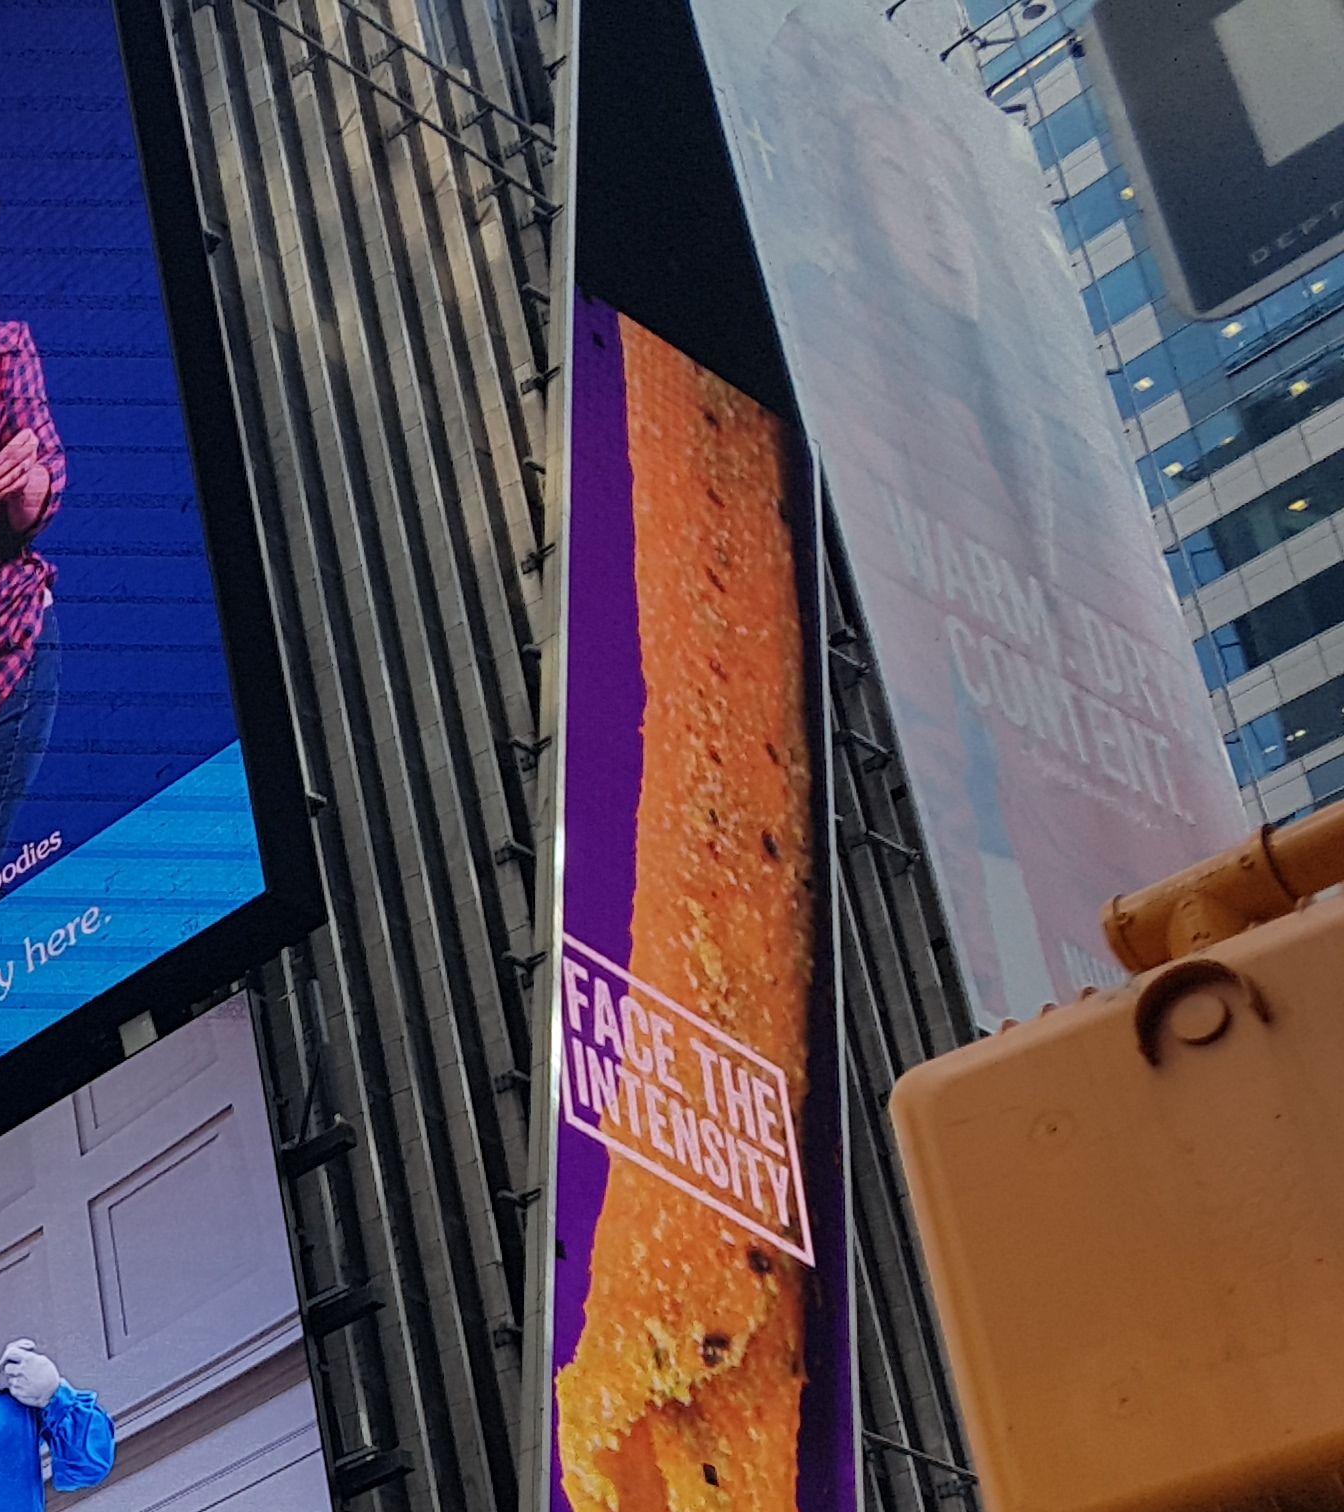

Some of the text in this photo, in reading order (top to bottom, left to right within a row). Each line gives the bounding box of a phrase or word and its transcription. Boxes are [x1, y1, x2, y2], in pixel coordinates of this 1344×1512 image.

[23, 906, 111, 973] here.
[563, 956, 786, 1158] FACE THE
[572, 1037, 790, 1227] INTENSITY
